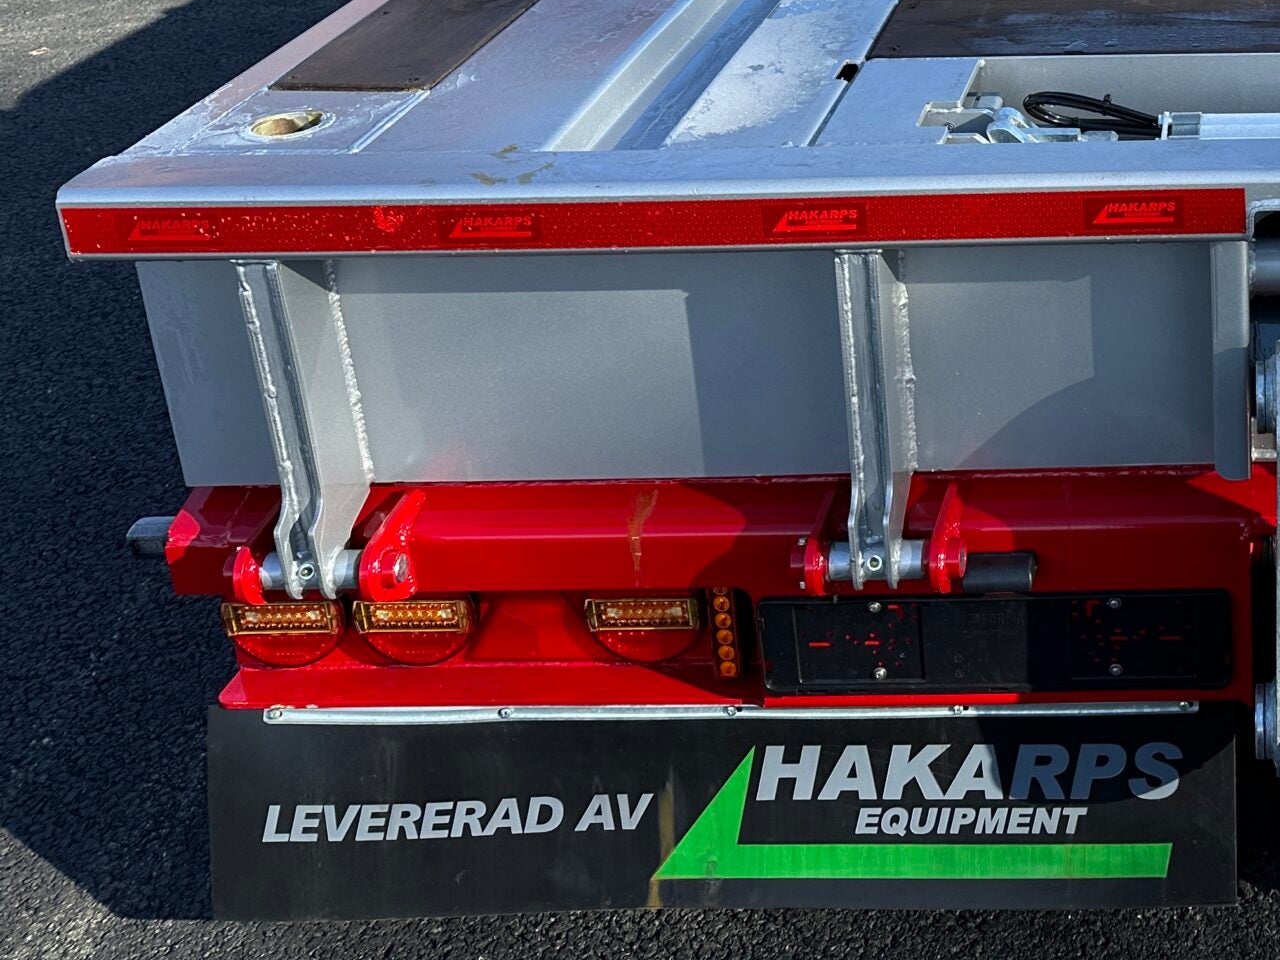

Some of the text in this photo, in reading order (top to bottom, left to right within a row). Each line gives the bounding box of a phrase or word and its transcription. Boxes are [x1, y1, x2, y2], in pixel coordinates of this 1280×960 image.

[788, 208, 859, 221] HAKARPS
[1107, 201, 1177, 213] HAKARPS
[462, 215, 532, 227] HAKARPS
[755, 741, 1184, 802] HAKARPS
[262, 793, 654, 843] LEVERERAD AV
[854, 806, 1088, 837] EQUIPMENT
